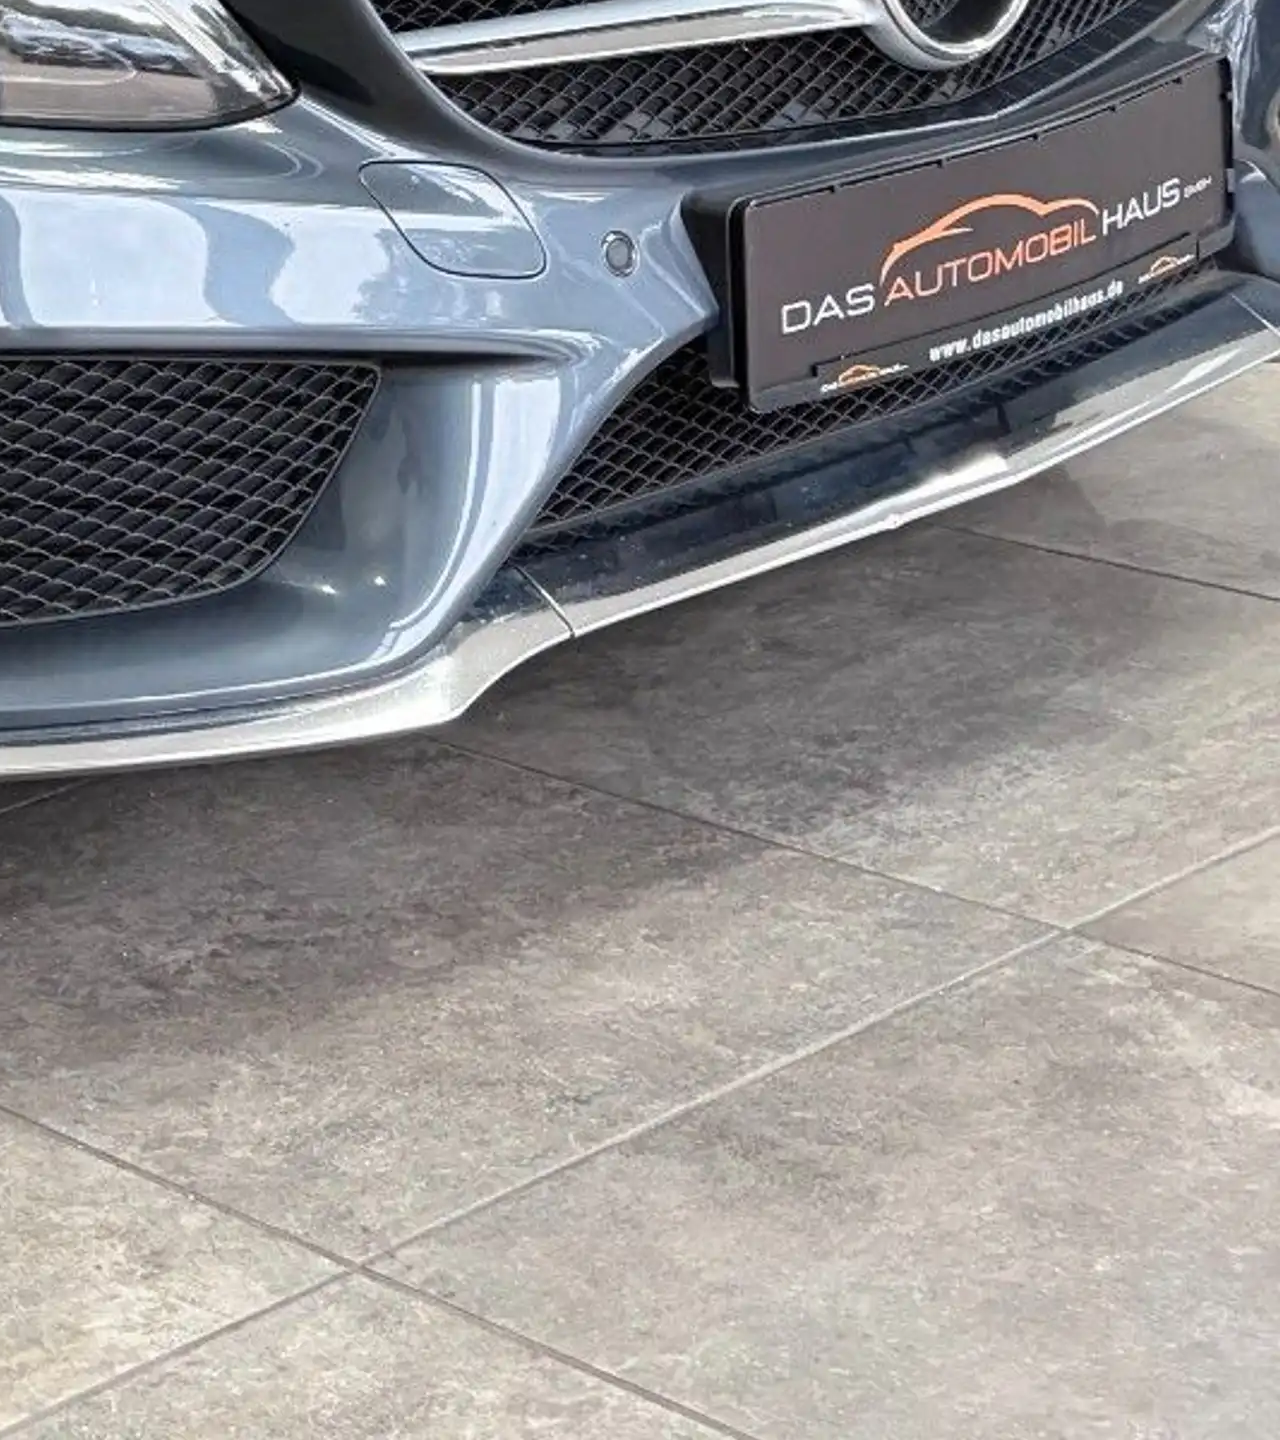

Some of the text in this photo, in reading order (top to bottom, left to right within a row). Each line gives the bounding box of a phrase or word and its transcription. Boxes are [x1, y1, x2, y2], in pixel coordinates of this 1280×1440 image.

[781, 283, 876, 335] DAS
[883, 218, 1097, 307] AUTOMOBIL
[1102, 177, 1181, 236] HAUS
[929, 278, 1124, 362] www.dasautomobilhaus.de
